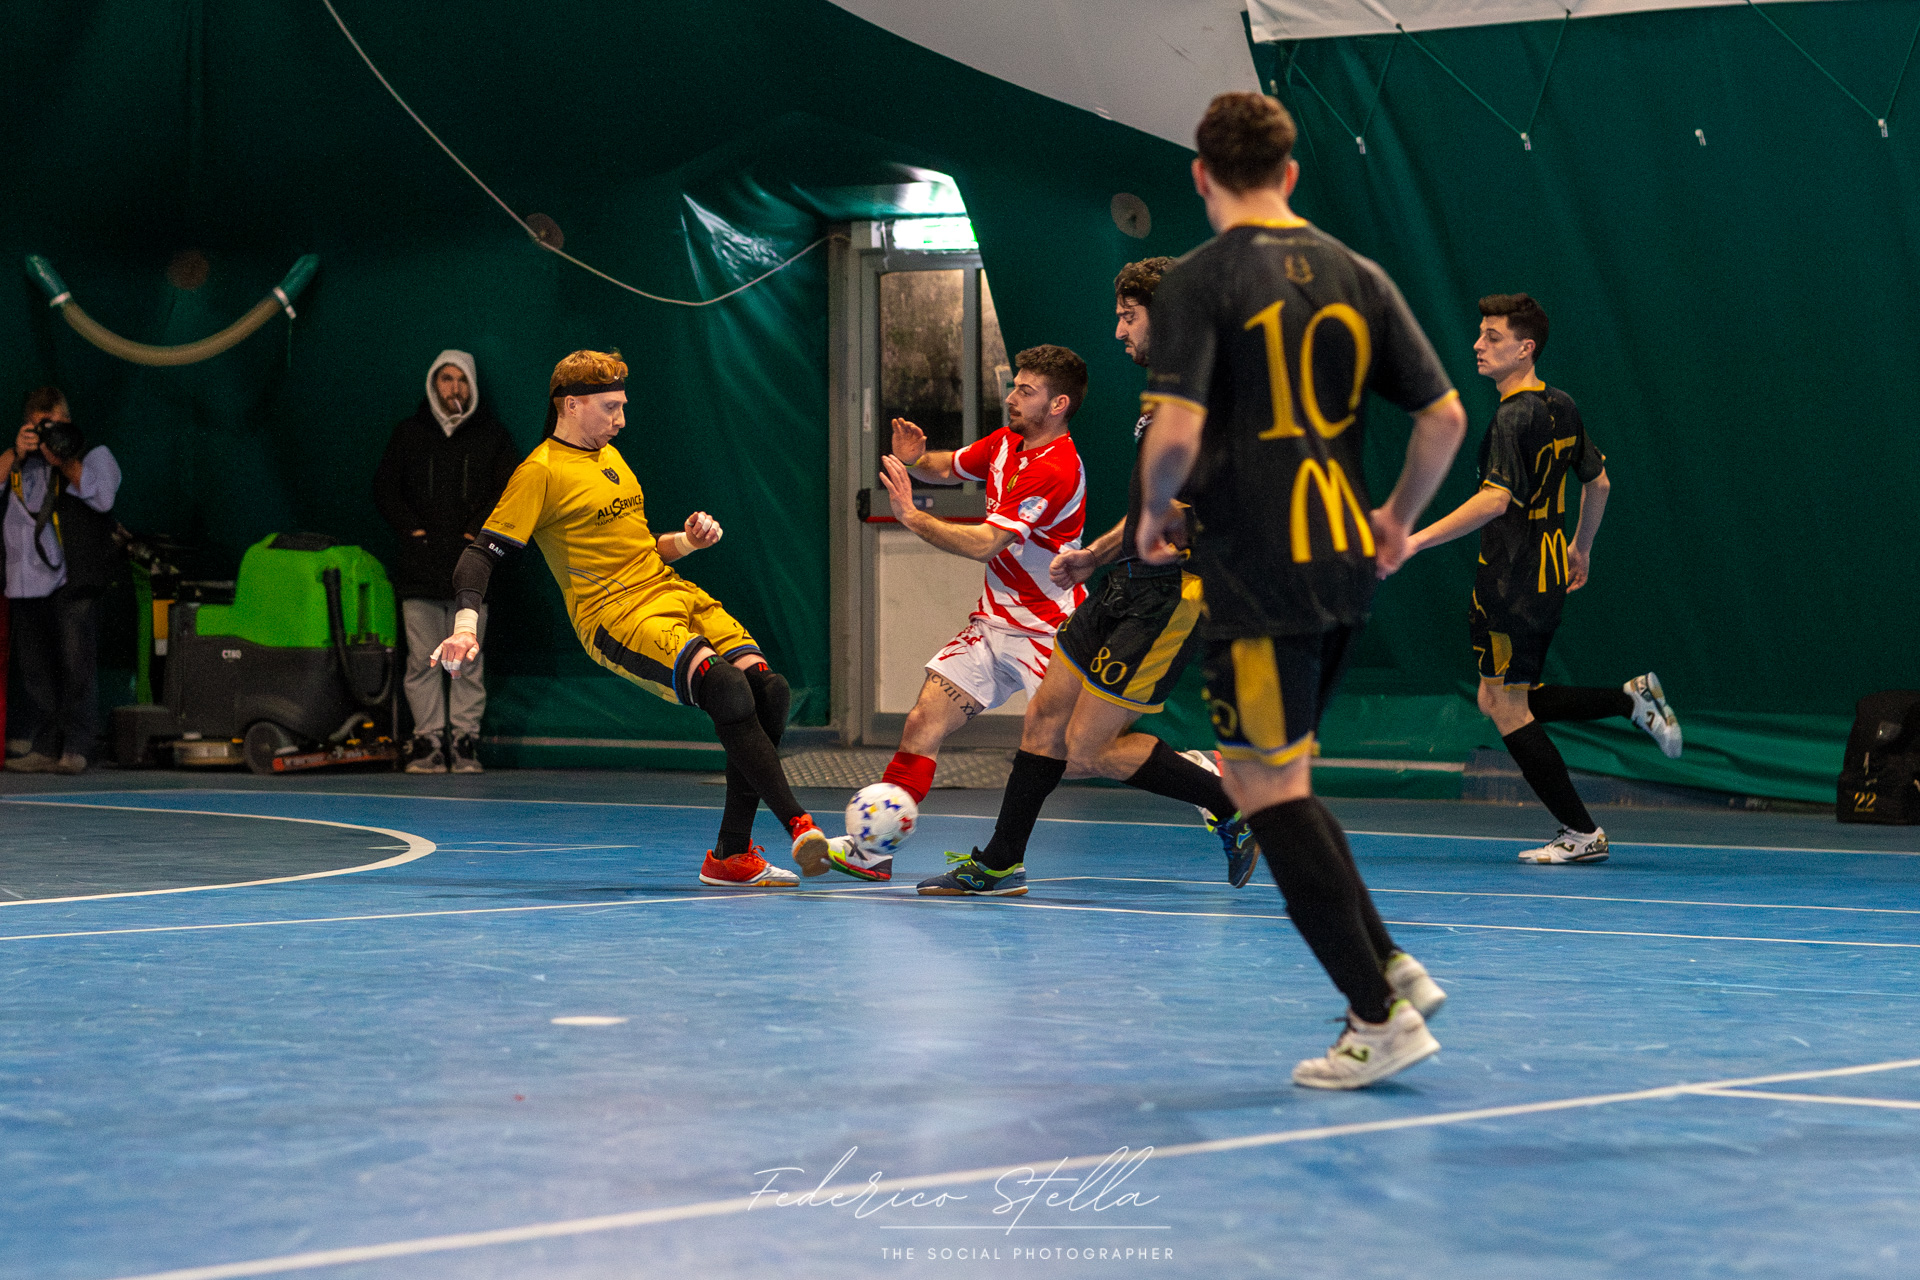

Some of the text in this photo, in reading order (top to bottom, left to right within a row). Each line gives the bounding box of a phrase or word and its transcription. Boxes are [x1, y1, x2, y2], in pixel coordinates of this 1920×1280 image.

[1244, 300, 1372, 439] 10
[1528, 435, 1577, 520] 27
[1090, 646, 1128, 685] 80
